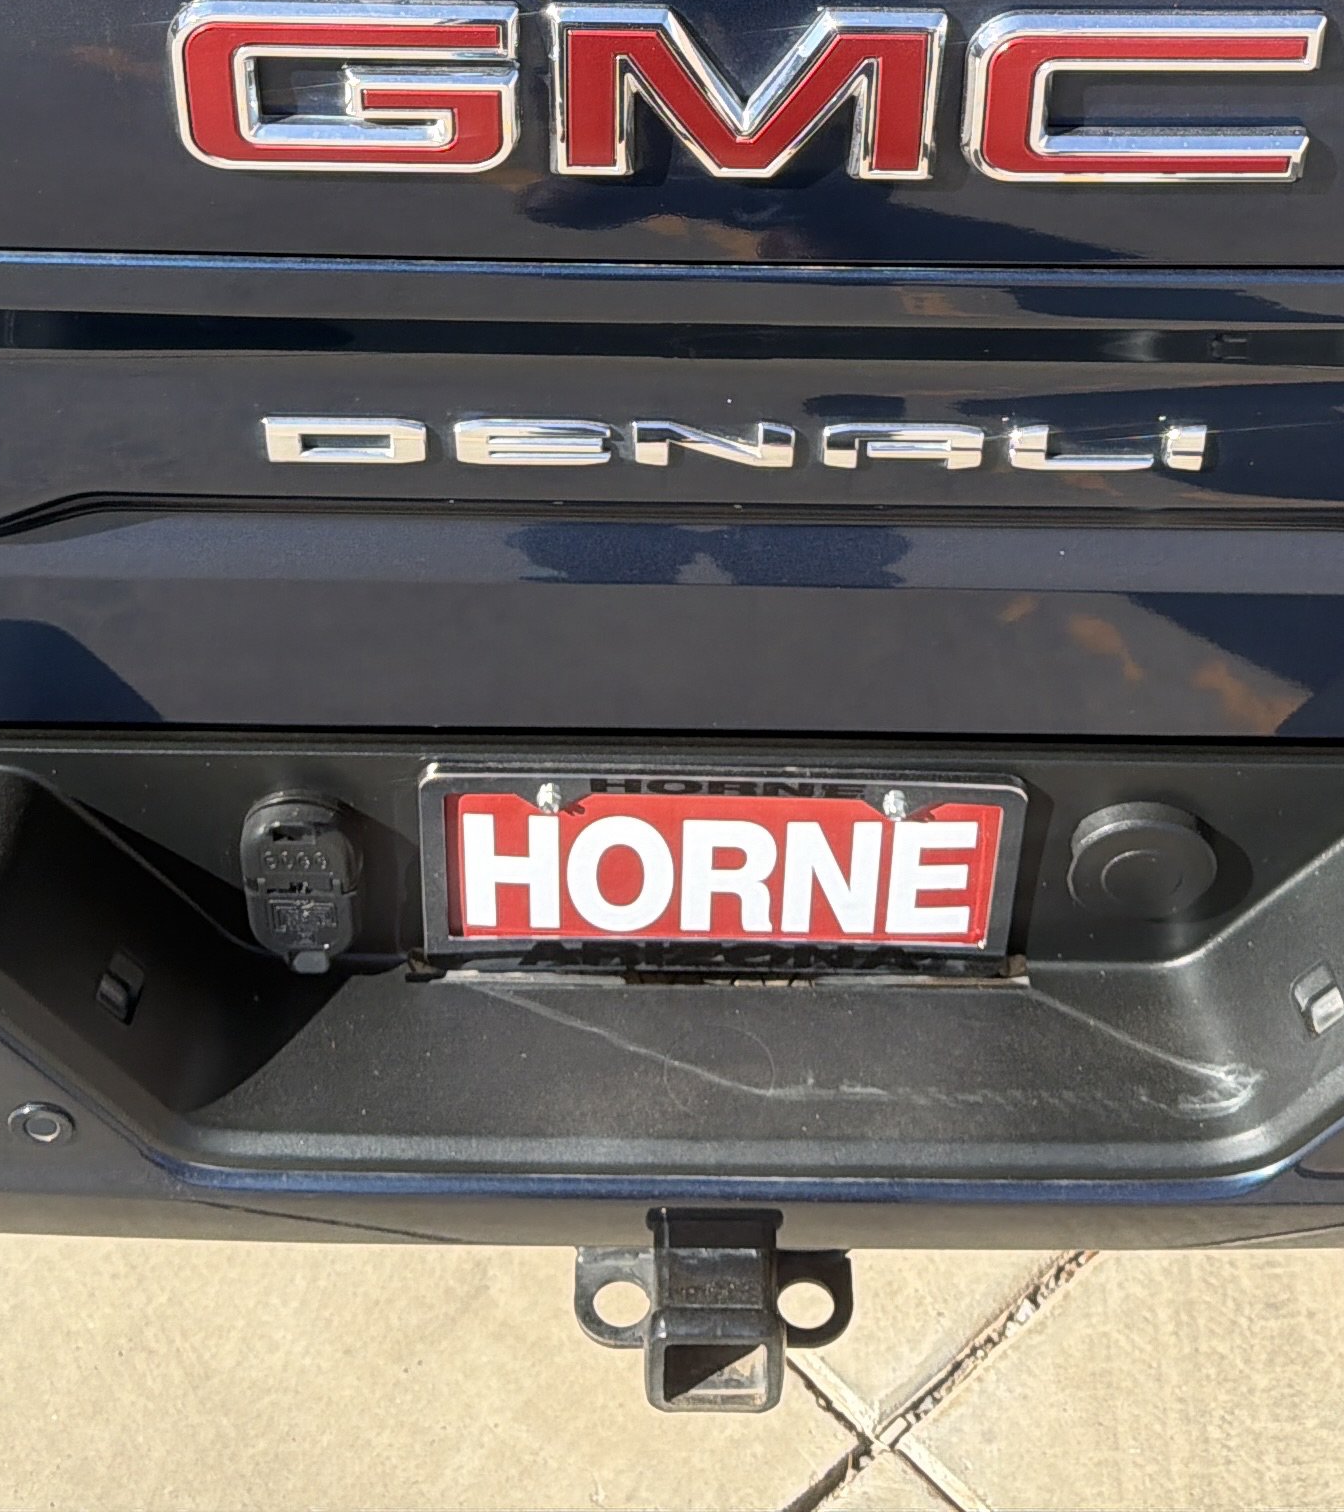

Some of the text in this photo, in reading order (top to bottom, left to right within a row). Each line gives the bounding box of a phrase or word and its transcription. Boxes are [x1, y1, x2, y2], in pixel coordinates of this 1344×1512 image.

[260, 415, 1208, 472] DENALI
[589, 777, 866, 799] HORNE
[461, 812, 979, 935] HORNE
[517, 941, 921, 970] ARIZONA
